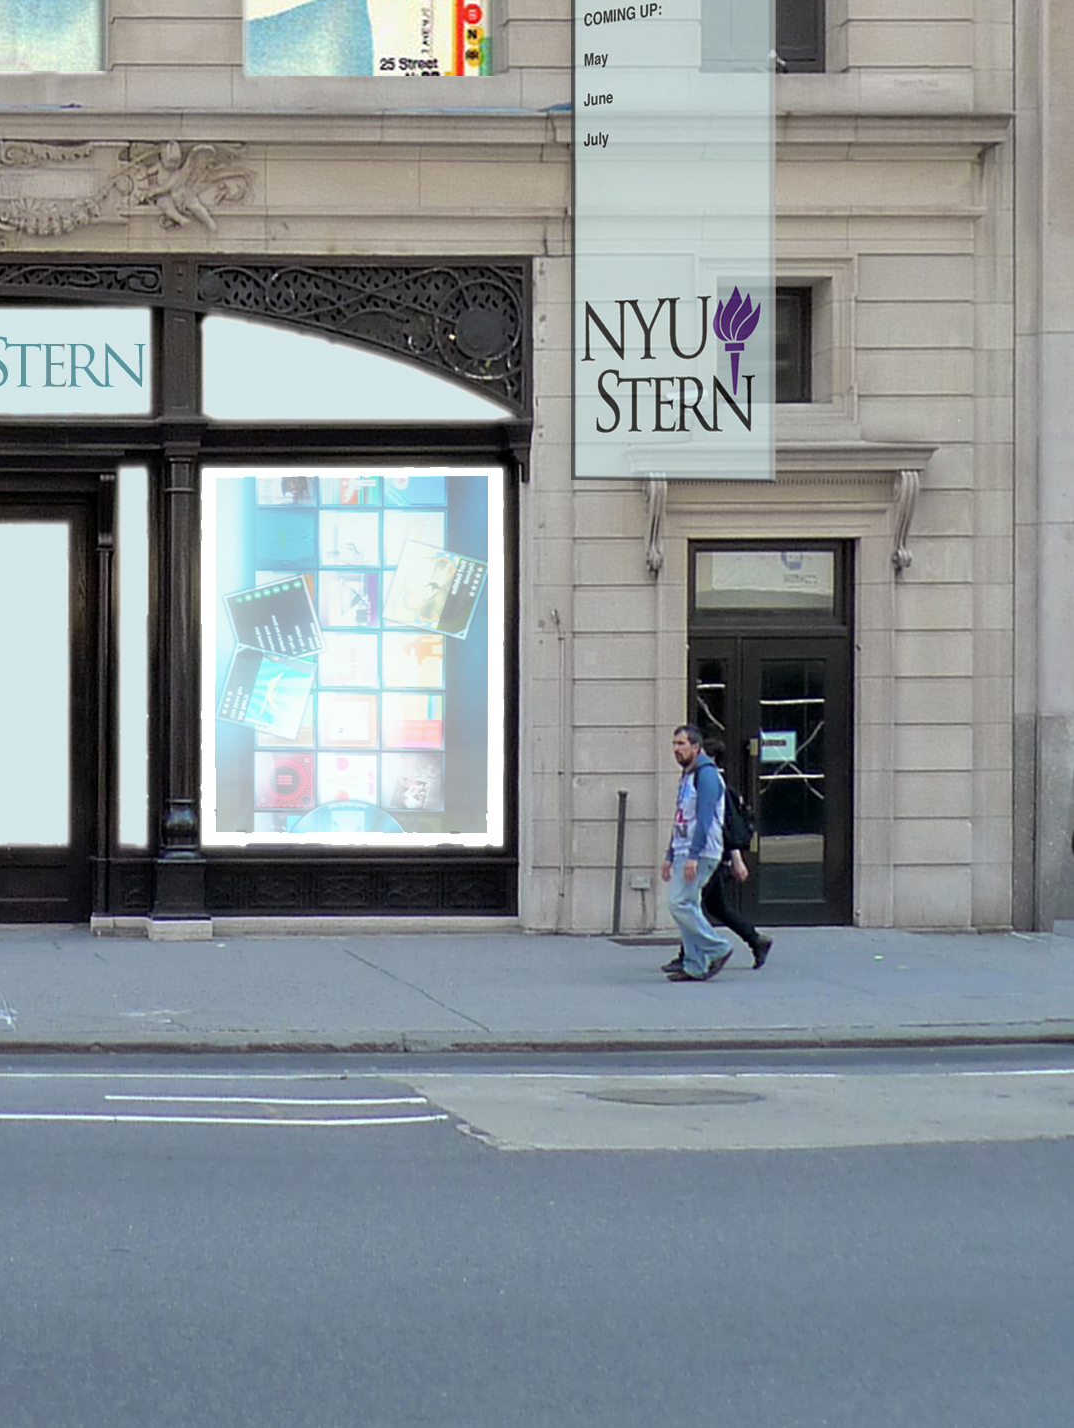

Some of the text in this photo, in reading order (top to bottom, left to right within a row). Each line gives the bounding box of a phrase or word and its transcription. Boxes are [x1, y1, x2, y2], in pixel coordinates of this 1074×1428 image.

[584, 3, 662, 27] COMING UP:
[380, 57, 438, 70] 25 Street
[584, 52, 608, 68] May
[584, 92, 613, 107] June
[584, 132, 609, 148] July
[581, 296, 711, 362] NYU
[596, 369, 755, 433] STERN
